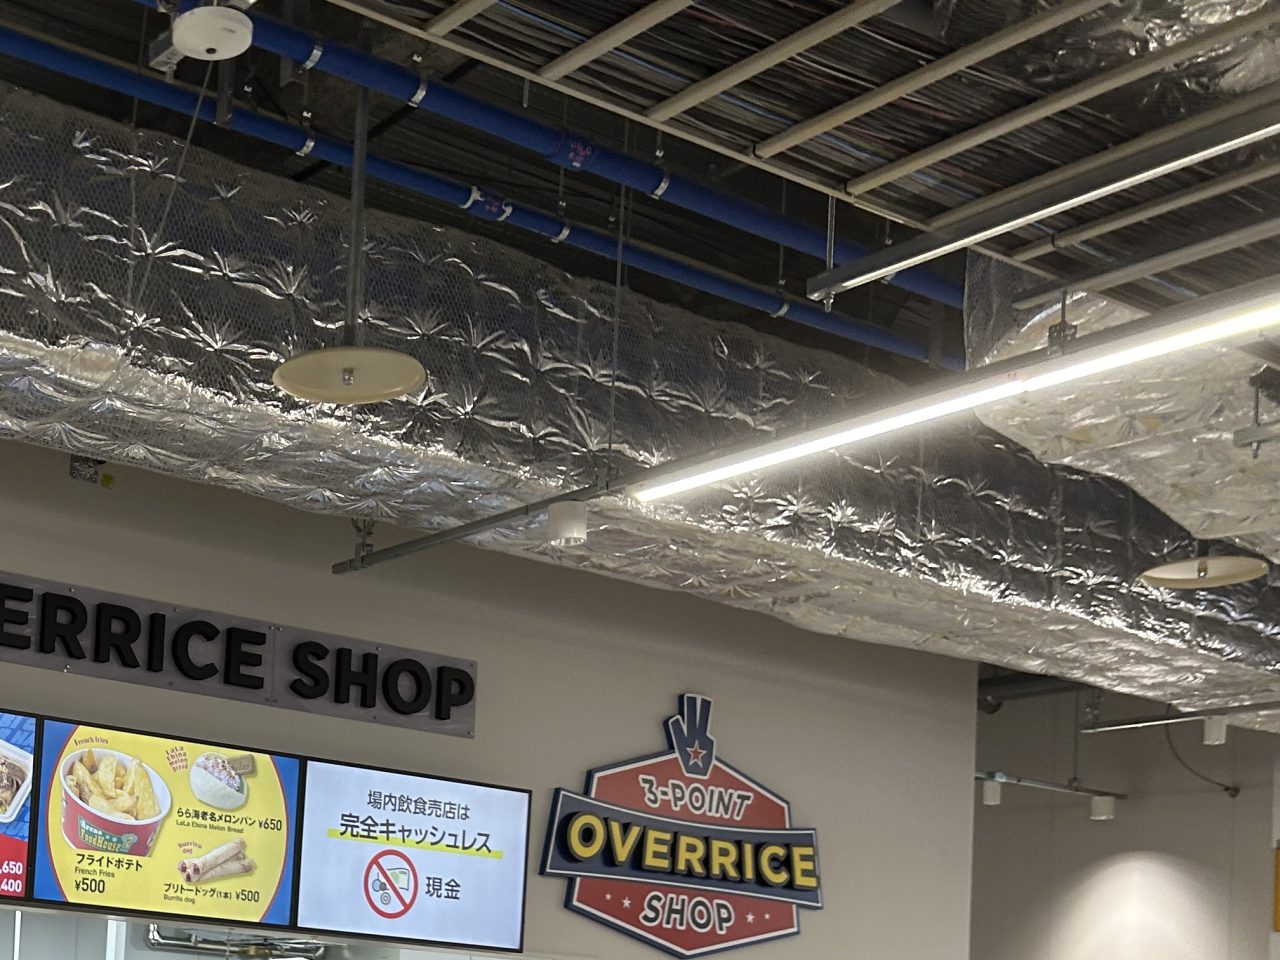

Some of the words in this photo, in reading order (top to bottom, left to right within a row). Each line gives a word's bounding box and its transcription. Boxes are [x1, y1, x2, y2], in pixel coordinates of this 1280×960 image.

[289, 640, 475, 721] SHOP
[367, 790, 470, 820] 場内飲食売店は
[638, 774, 753, 821] 3-POINT
[177, 807, 256, 826] らら海老名メロンパン
[258, 818, 282, 831] ¥650
[340, 814, 492, 853] 完全キャッシュレス
[76, 853, 142, 871] フライドポテト
[567, 811, 819, 890] OVERRICE
[75, 866, 97, 875] French
[99, 869, 115, 878] Fries
[75, 878, 105, 893] ¥500
[236, 889, 260, 902] ¥500
[425, 877, 461, 899] 現金
[639, 891, 735, 935] SHOP
